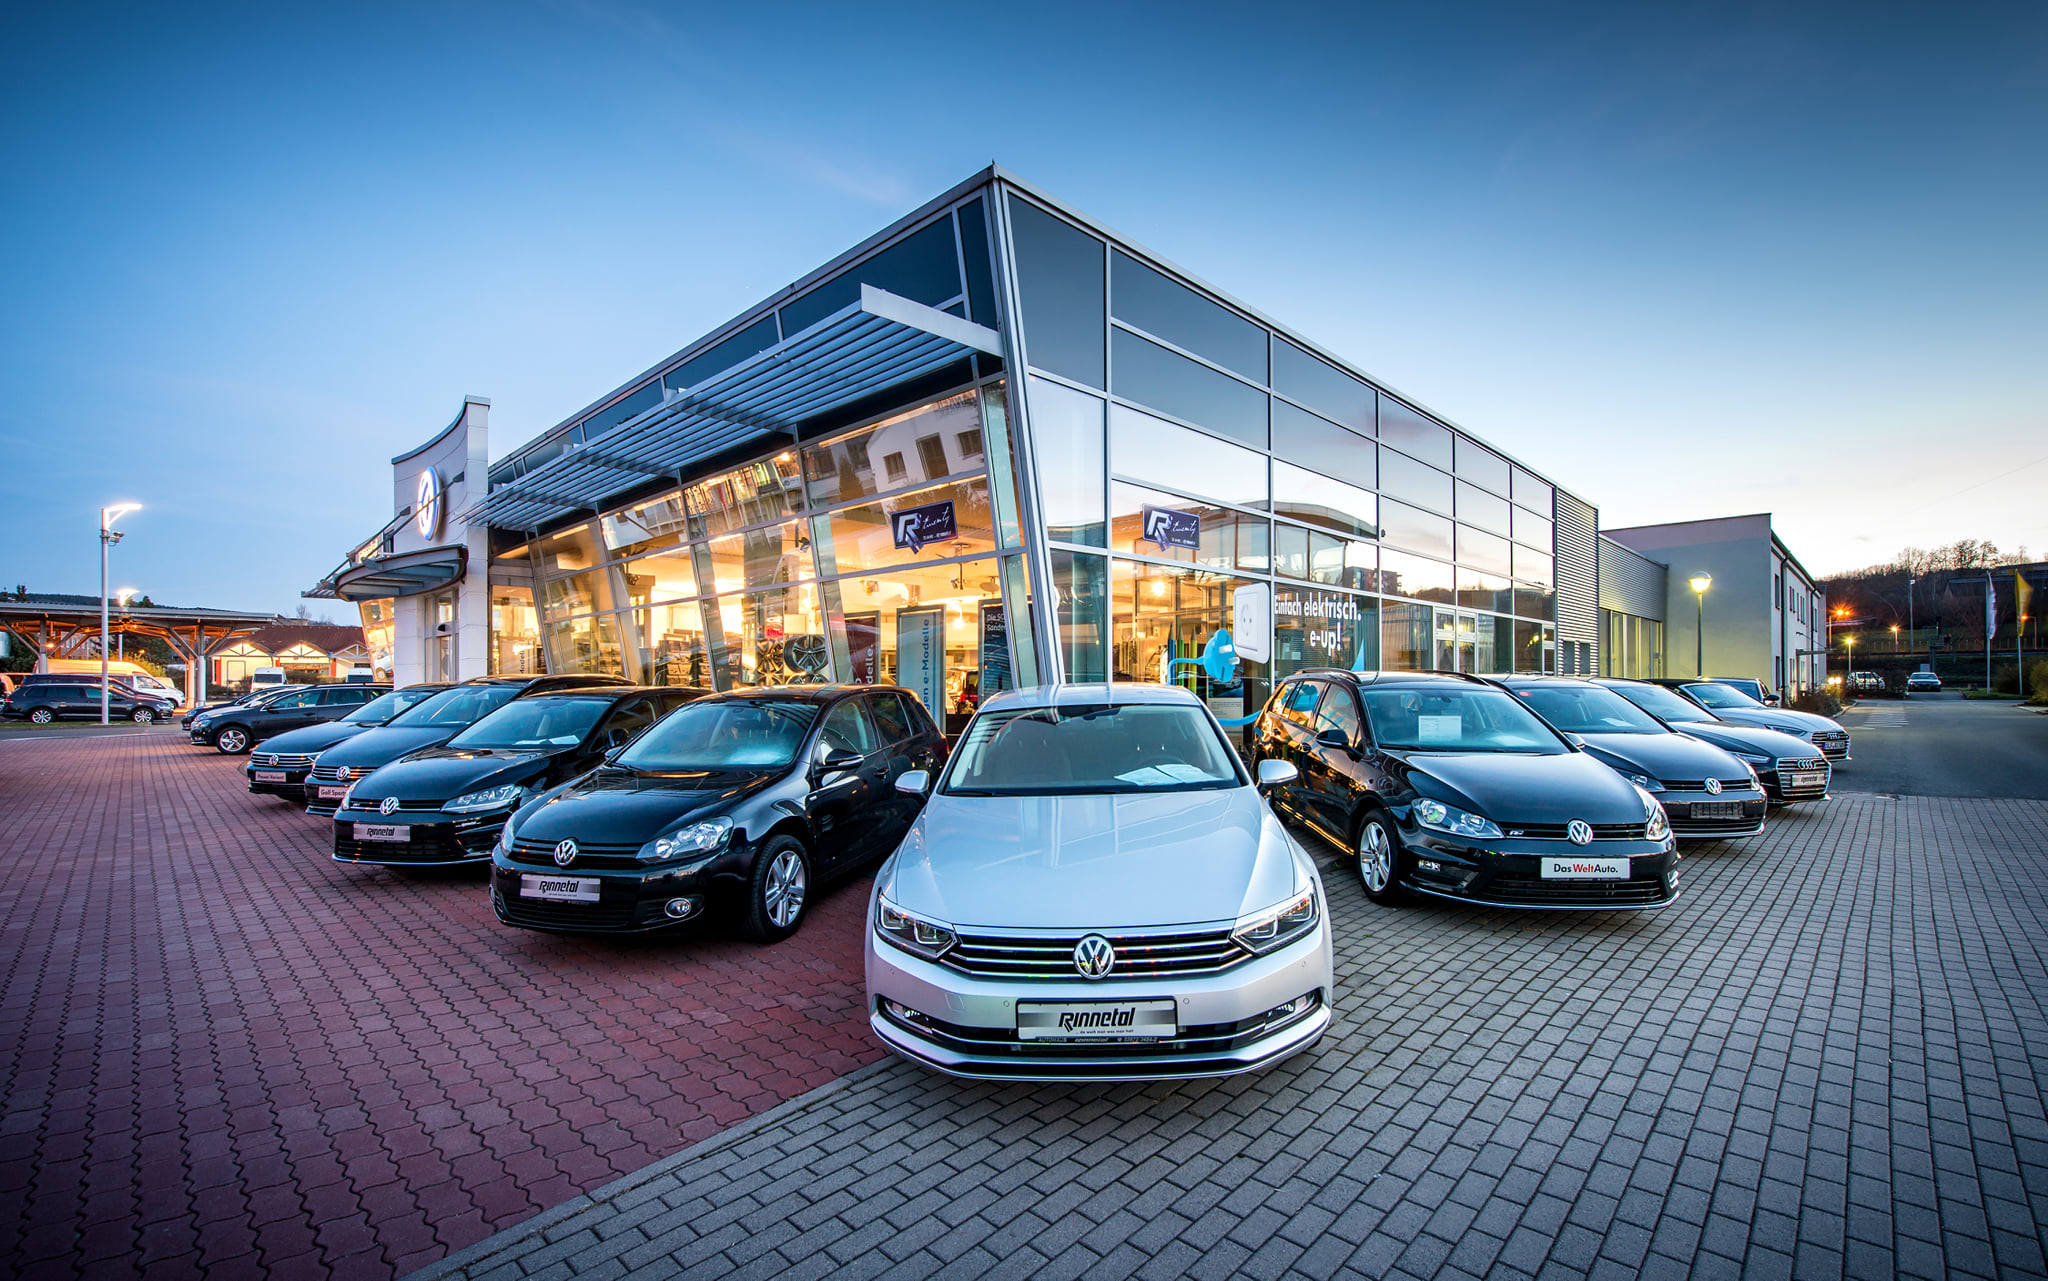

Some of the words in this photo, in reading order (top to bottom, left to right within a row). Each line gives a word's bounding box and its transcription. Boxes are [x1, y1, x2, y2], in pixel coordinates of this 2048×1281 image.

[1274, 592, 1302, 616] Einfach
[1304, 592, 1362, 621] elektrisch.
[922, 618, 931, 685] e-Modelle
[1310, 622, 1341, 656] e-up!
[1553, 863, 1572, 873] Das
[1573, 863, 1619, 873] WeltAuto.
[538, 880, 580, 894] Rinnetal
[1058, 1007, 1136, 1033] Rinnetal
